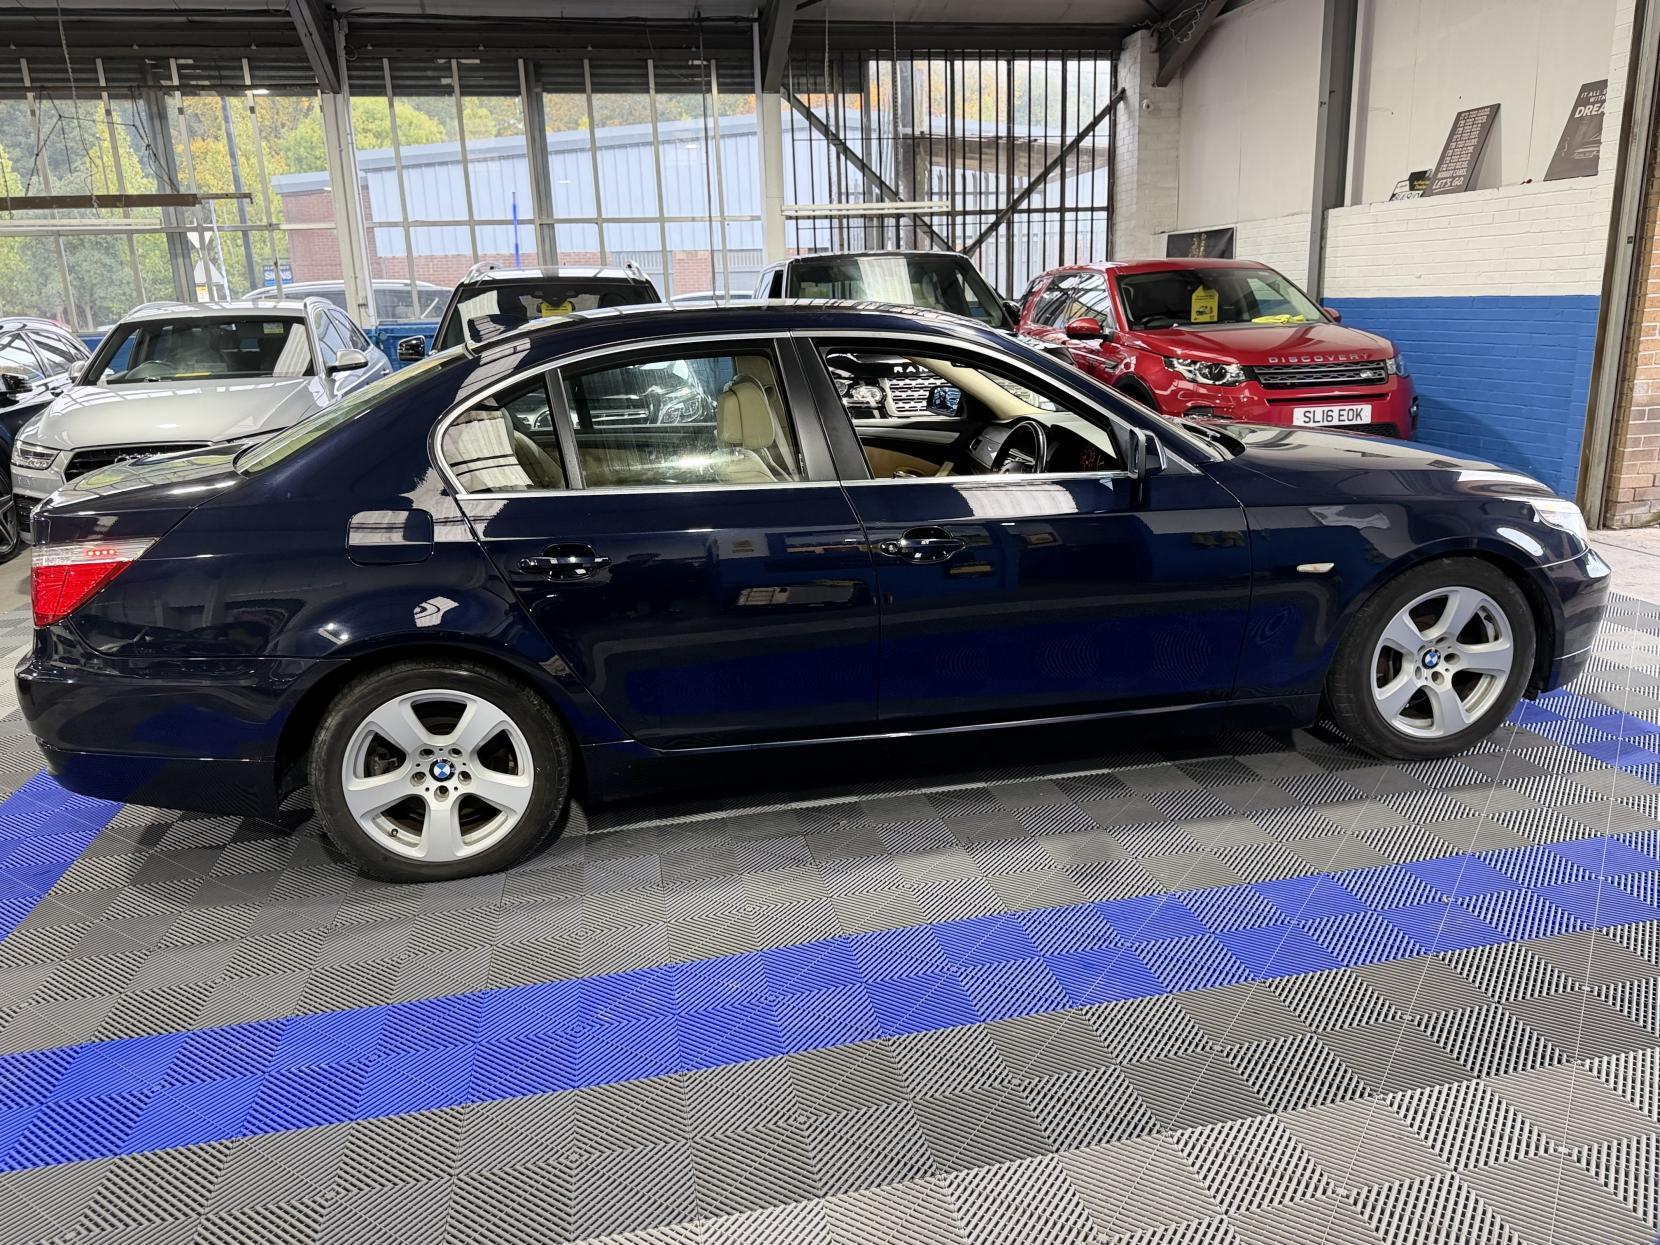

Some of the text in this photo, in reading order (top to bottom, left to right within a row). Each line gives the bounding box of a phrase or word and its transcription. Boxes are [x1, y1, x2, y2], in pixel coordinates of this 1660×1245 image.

[1432, 179, 1451, 189] LET'S
[1268, 353, 1370, 364] DISCOVERY
[1303, 407, 1363, 424] SL16 EOK
